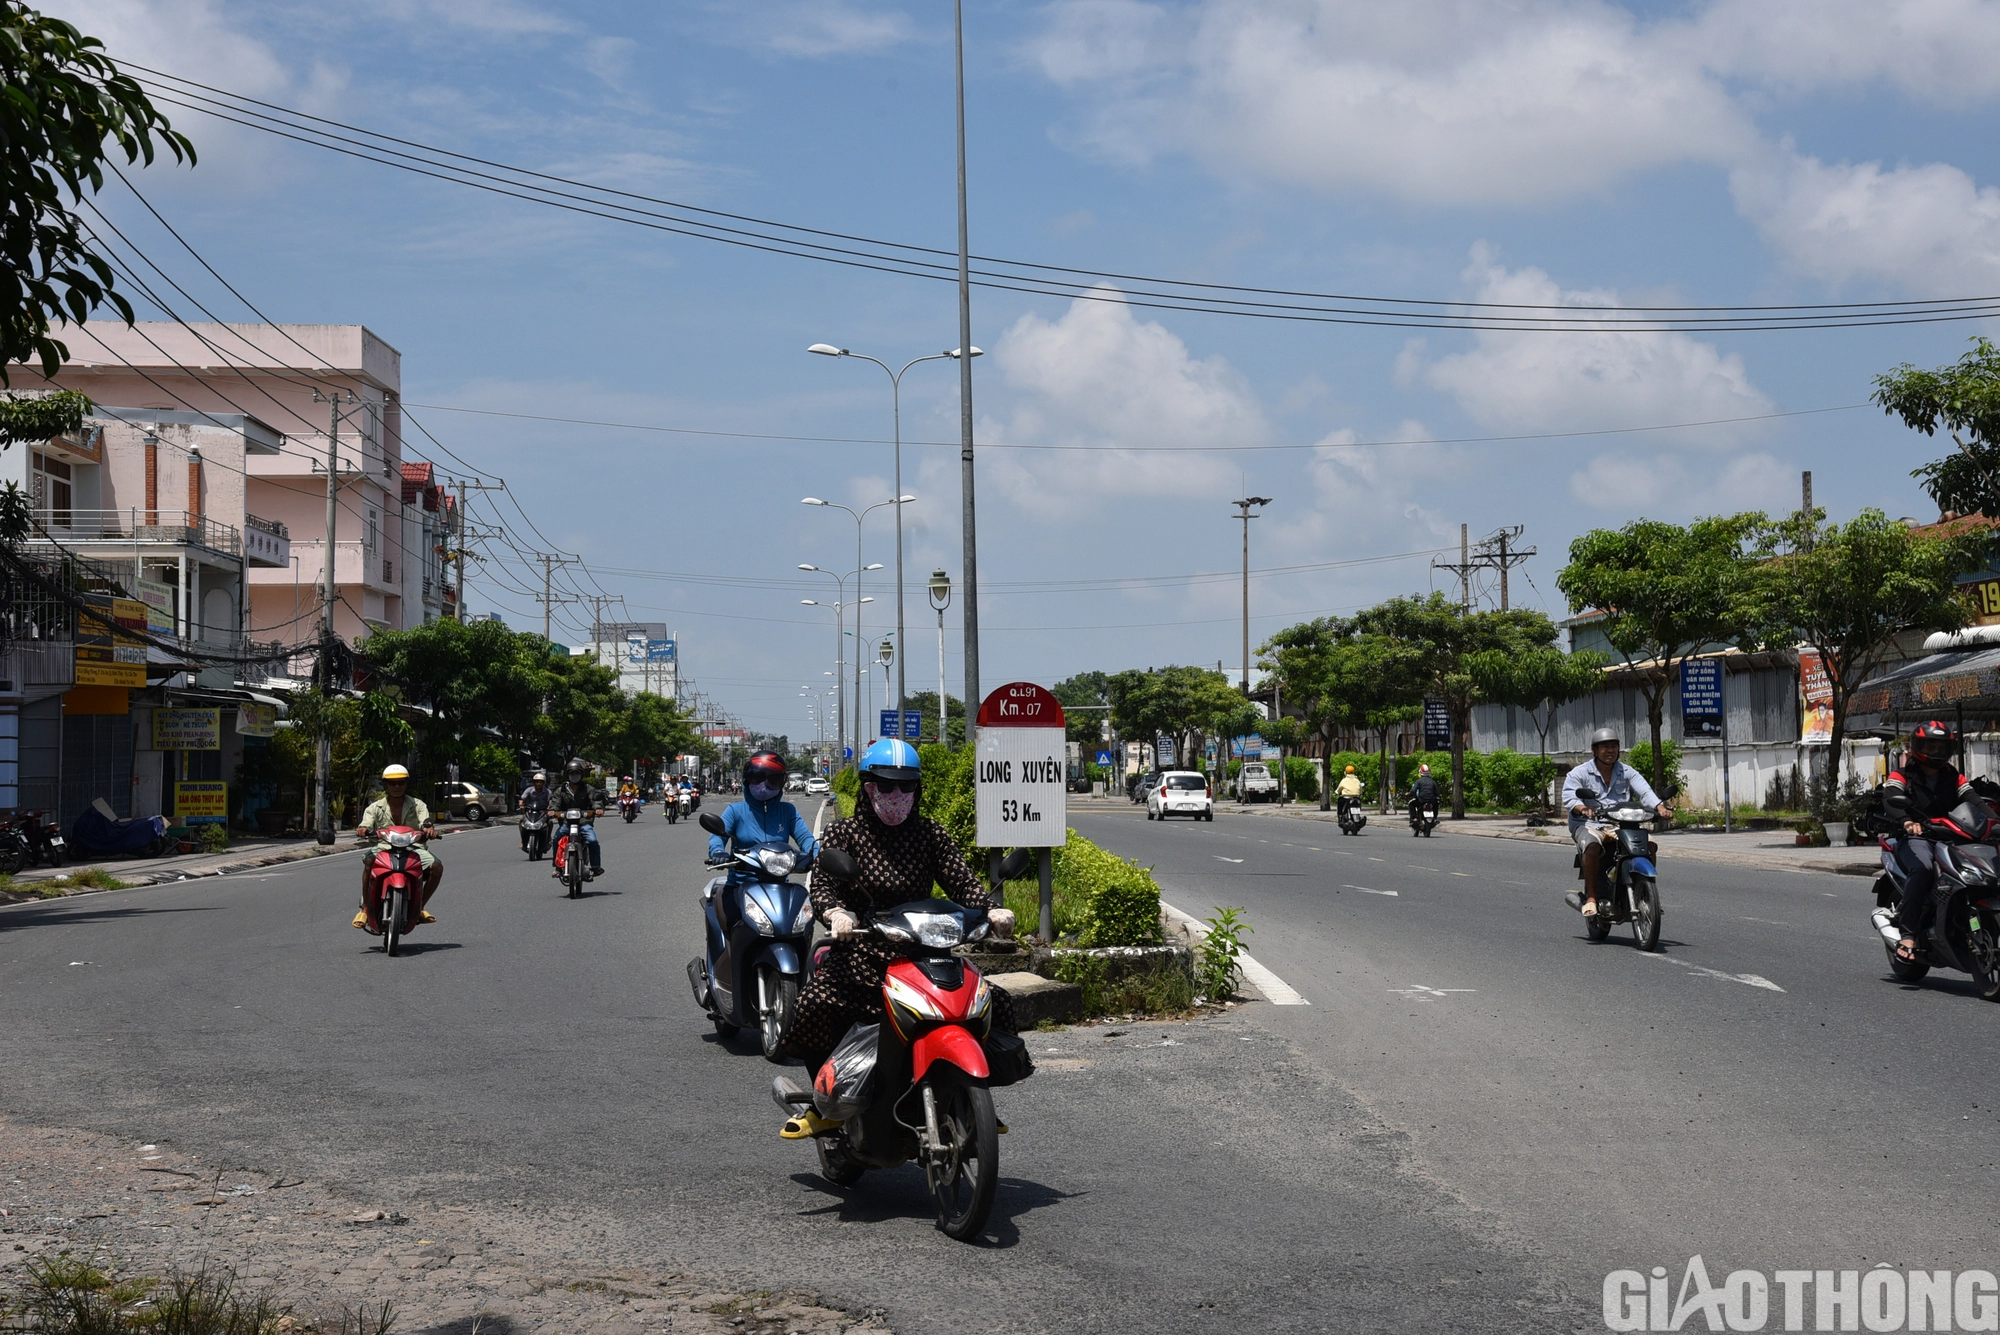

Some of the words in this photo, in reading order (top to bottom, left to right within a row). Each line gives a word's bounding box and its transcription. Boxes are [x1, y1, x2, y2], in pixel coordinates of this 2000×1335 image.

[1944, 676, 1980, 698] COFFEE
[980, 760, 1011, 783] LONG
[1022, 756, 1061, 783] XUYÊN
[1002, 800, 1017, 822] 53
[1023, 803, 1041, 821] Km
